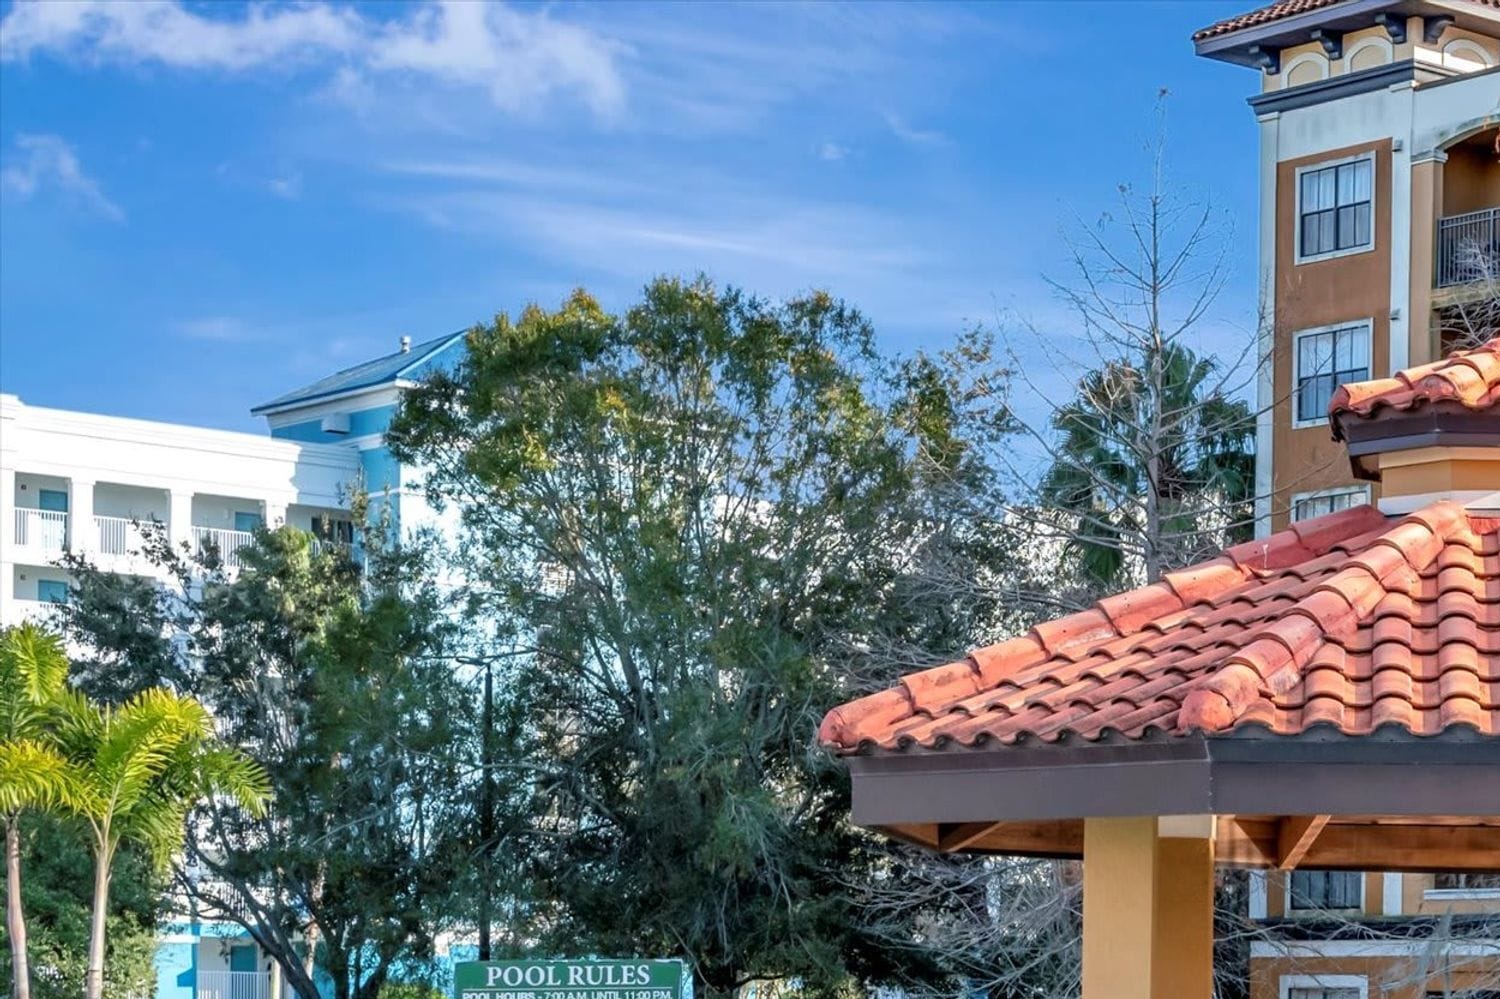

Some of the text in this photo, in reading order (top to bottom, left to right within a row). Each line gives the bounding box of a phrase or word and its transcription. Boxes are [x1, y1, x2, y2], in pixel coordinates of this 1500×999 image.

[487, 966, 650, 986] POOL RULES
[568, 992, 589, 999] A.M.
[592, 992, 621, 999] UNTIL
[625, 991, 650, 999] 11:00
[653, 991, 673, 999] P.M.
